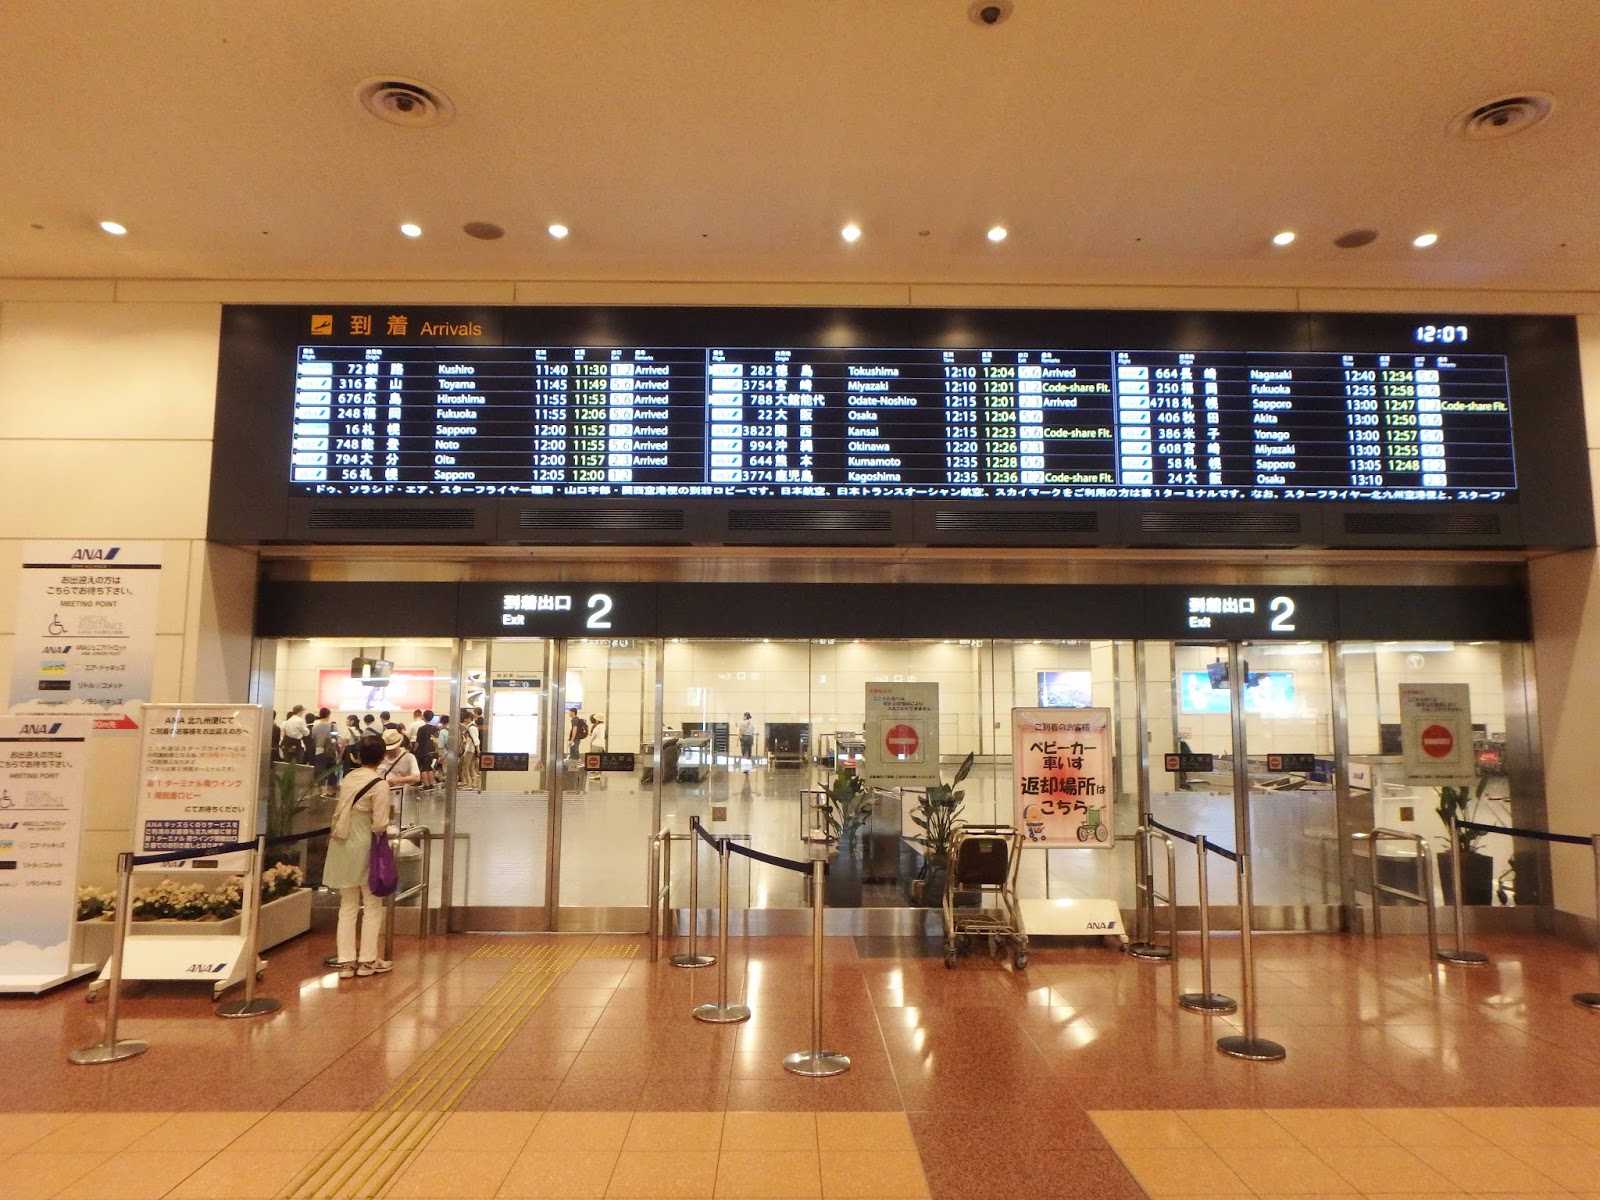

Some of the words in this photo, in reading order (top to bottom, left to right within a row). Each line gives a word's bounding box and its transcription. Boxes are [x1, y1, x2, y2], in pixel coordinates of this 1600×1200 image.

[420, 322, 482, 336] Arrivals
[1416, 326, 1468, 342] 12:07
[348, 364, 363, 374] 72
[438, 364, 475, 374] Kushiro
[536, 365, 568, 375] 11:40
[575, 365, 607, 375] 11:30
[635, 365, 669, 375] Arrived
[751, 365, 772, 376] 282
[848, 367, 899, 376] Tokushima
[944, 367, 976, 378] 12:10
[983, 367, 1015, 378] 12:04
[1043, 368, 1076, 378] Arrived
[1155, 369, 1177, 379] 664
[1250, 370, 1292, 381] Nagasaki
[1344, 371, 1376, 382] 12:40
[1382, 371, 1413, 382] 12:34
[339, 379, 362, 389] 316
[438, 379, 476, 390] Toyama
[535, 380, 567, 390] 11:45
[575, 380, 607, 390] 11:49
[635, 380, 669, 390] Arrived
[743, 380, 772, 391] 3754
[848, 381, 889, 392] Miyazaki
[945, 382, 976, 393] 12:10
[984, 382, 1014, 393] 12:01
[1043, 382, 1095, 393] Code-share
[1097, 383, 1110, 393] Flt.
[1157, 383, 1179, 393] 250
[1251, 384, 1290, 394] Fukuoka
[1345, 385, 1376, 396] 12:55
[1383, 385, 1415, 396] 12:58
[338, 394, 361, 404] 676
[437, 394, 486, 404] Hiroshima
[535, 394, 567, 405] 11:55
[575, 394, 606, 405] 11:53
[634, 395, 668, 405] Arrived
[751, 395, 772, 405] 788
[848, 396, 917, 406] Odate-Noshiro
[945, 396, 977, 407] 12:15
[984, 396, 1015, 407] 12:01
[1043, 397, 1077, 407] Arrived
[1150, 398, 1179, 408] 4718
[1253, 399, 1292, 410] Sapporo
[1347, 400, 1378, 411] 13:00
[1384, 400, 1415, 411] 12:47
[1441, 400, 1493, 410] Code-share
[337, 408, 361, 418] 248
[436, 409, 477, 419] Fukuoka
[535, 409, 567, 420] 11:55
[575, 409, 606, 420] 12:06
[634, 409, 668, 420] Arrived
[758, 410, 772, 420] 22
[848, 411, 877, 420] Osaka
[945, 411, 977, 422] 12:15
[985, 411, 1016, 422] 12:04
[1158, 413, 1180, 423] 406
[1254, 414, 1277, 424] Akita
[1347, 415, 1379, 425] 13:00
[1385, 415, 1417, 425] 12:50
[345, 424, 360, 434] 16
[436, 425, 477, 437] Sapporo
[534, 425, 566, 436] 12:00
[574, 425, 606, 436] 11:52
[634, 425, 668, 436] Arrived
[743, 426, 772, 436] 3822
[848, 427, 879, 436] Kansai
[946, 427, 977, 438] 12:15
[985, 427, 1016, 438] 12:23
[1044, 428, 1097, 438] Code-share
[1098, 428, 1112, 438] Flt.
[1159, 429, 1180, 439] 386
[1254, 430, 1290, 441] Yonago
[1348, 430, 1379, 441] 13:00
[1387, 430, 1417, 441] 12:57
[336, 439, 359, 450] 748
[435, 440, 459, 450] Noto
[534, 440, 566, 450] 12:00
[573, 440, 605, 450] 11:55
[633, 440, 668, 450] Arrived
[750, 440, 772, 451] 994
[848, 442, 890, 451] Okinawa
[946, 442, 978, 453] 12:20
[985, 442, 1017, 453] 12:26
[1159, 444, 1181, 454] 608
[1255, 445, 1295, 456] Miyazaki
[1350, 445, 1381, 456] 13:00
[1387, 445, 1418, 456] 12:55
[335, 454, 358, 464] 794
[435, 454, 455, 464] Oita
[533, 455, 566, 465] 12:00
[573, 455, 605, 465] 11:57
[633, 455, 667, 465] Arrived
[750, 456, 772, 465] 644
[848, 457, 901, 466] Kumamoto
[946, 457, 978, 468] 12:35
[985, 457, 1018, 468] 12:28
[1168, 459, 1182, 469] 58
[1256, 460, 1296, 470] Sapporo
[1350, 460, 1381, 470] 13:05
[1388, 460, 1420, 470] 12:48
[342, 469, 357, 480] 56
[434, 470, 475, 481] Sapporo
[533, 470, 565, 481] 12:05
[573, 470, 605, 481] 12:00
[743, 470, 772, 481] 3774
[848, 472, 901, 483] Kagoshima
[946, 472, 978, 483] 12:35
[986, 472, 1018, 483] 12:36
[1045, 473, 1098, 483] Code-share
[1099, 473, 1114, 483] Flt.
[1168, 473, 1182, 483] 24
[1257, 474, 1285, 484] Osaka
[1351, 475, 1383, 486] 13:10
[72, 549, 103, 560] ANA
[61, 576, 120, 584] お出迎えの方は
[586, 593, 613, 629] 2
[1271, 596, 1295, 632] 2
[502, 614, 525, 625] Exit
[1189, 617, 1211, 628] Exit
[19, 725, 47, 734] ANA
[1030, 741, 1096, 755] ベビーカー
[1043, 756, 1084, 770] 車いす
[1021, 776, 1106, 796] 返却場所は
[1041, 800, 1088, 815] こちら
[186, 965, 213, 973] ANA
